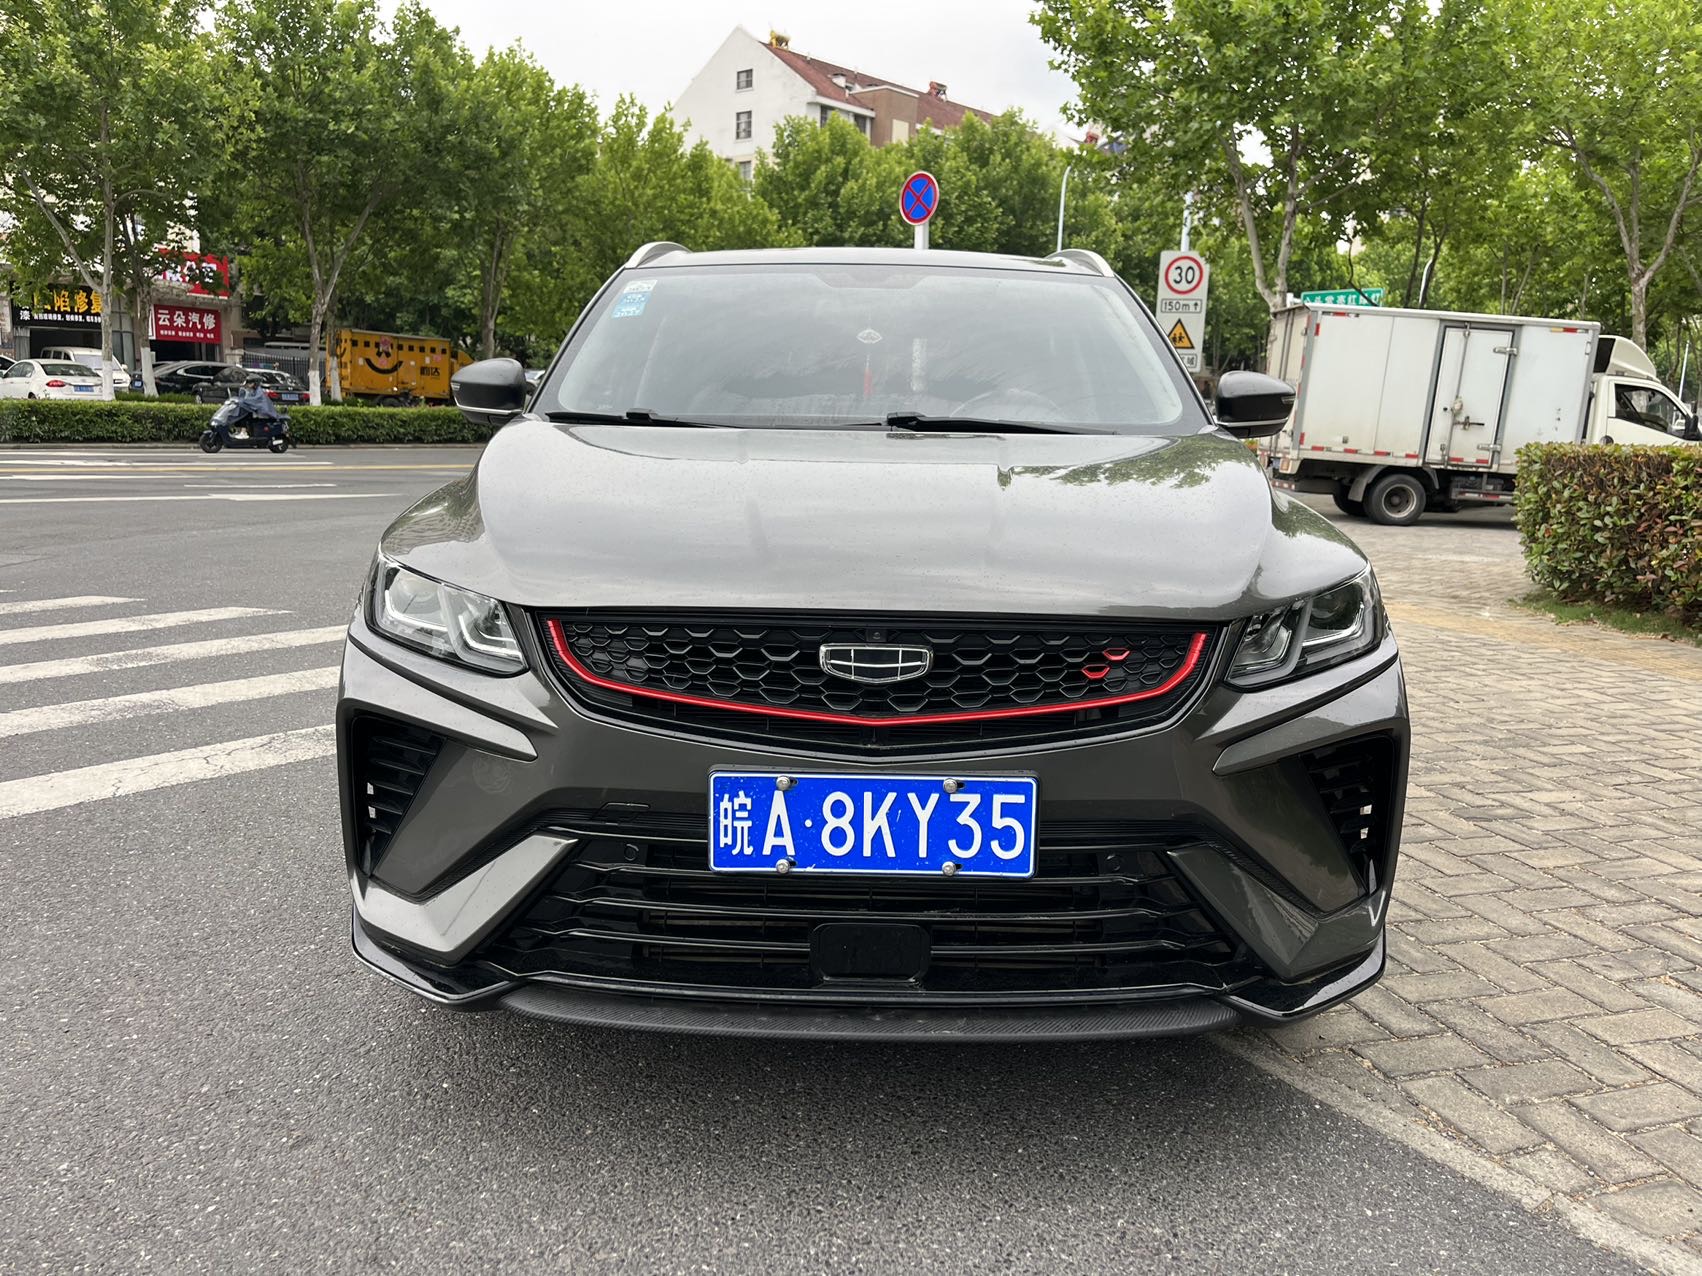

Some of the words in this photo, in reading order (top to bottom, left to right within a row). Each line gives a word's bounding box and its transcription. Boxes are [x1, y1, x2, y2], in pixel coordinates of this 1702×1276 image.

[1173, 266, 1195, 285] 30
[34, 289, 103, 313] 陷修复
[1163, 301, 1190, 311] 150m
[158, 309, 216, 330] 云朵汽修
[719, 790, 1026, 860] 皖A·8KY35
